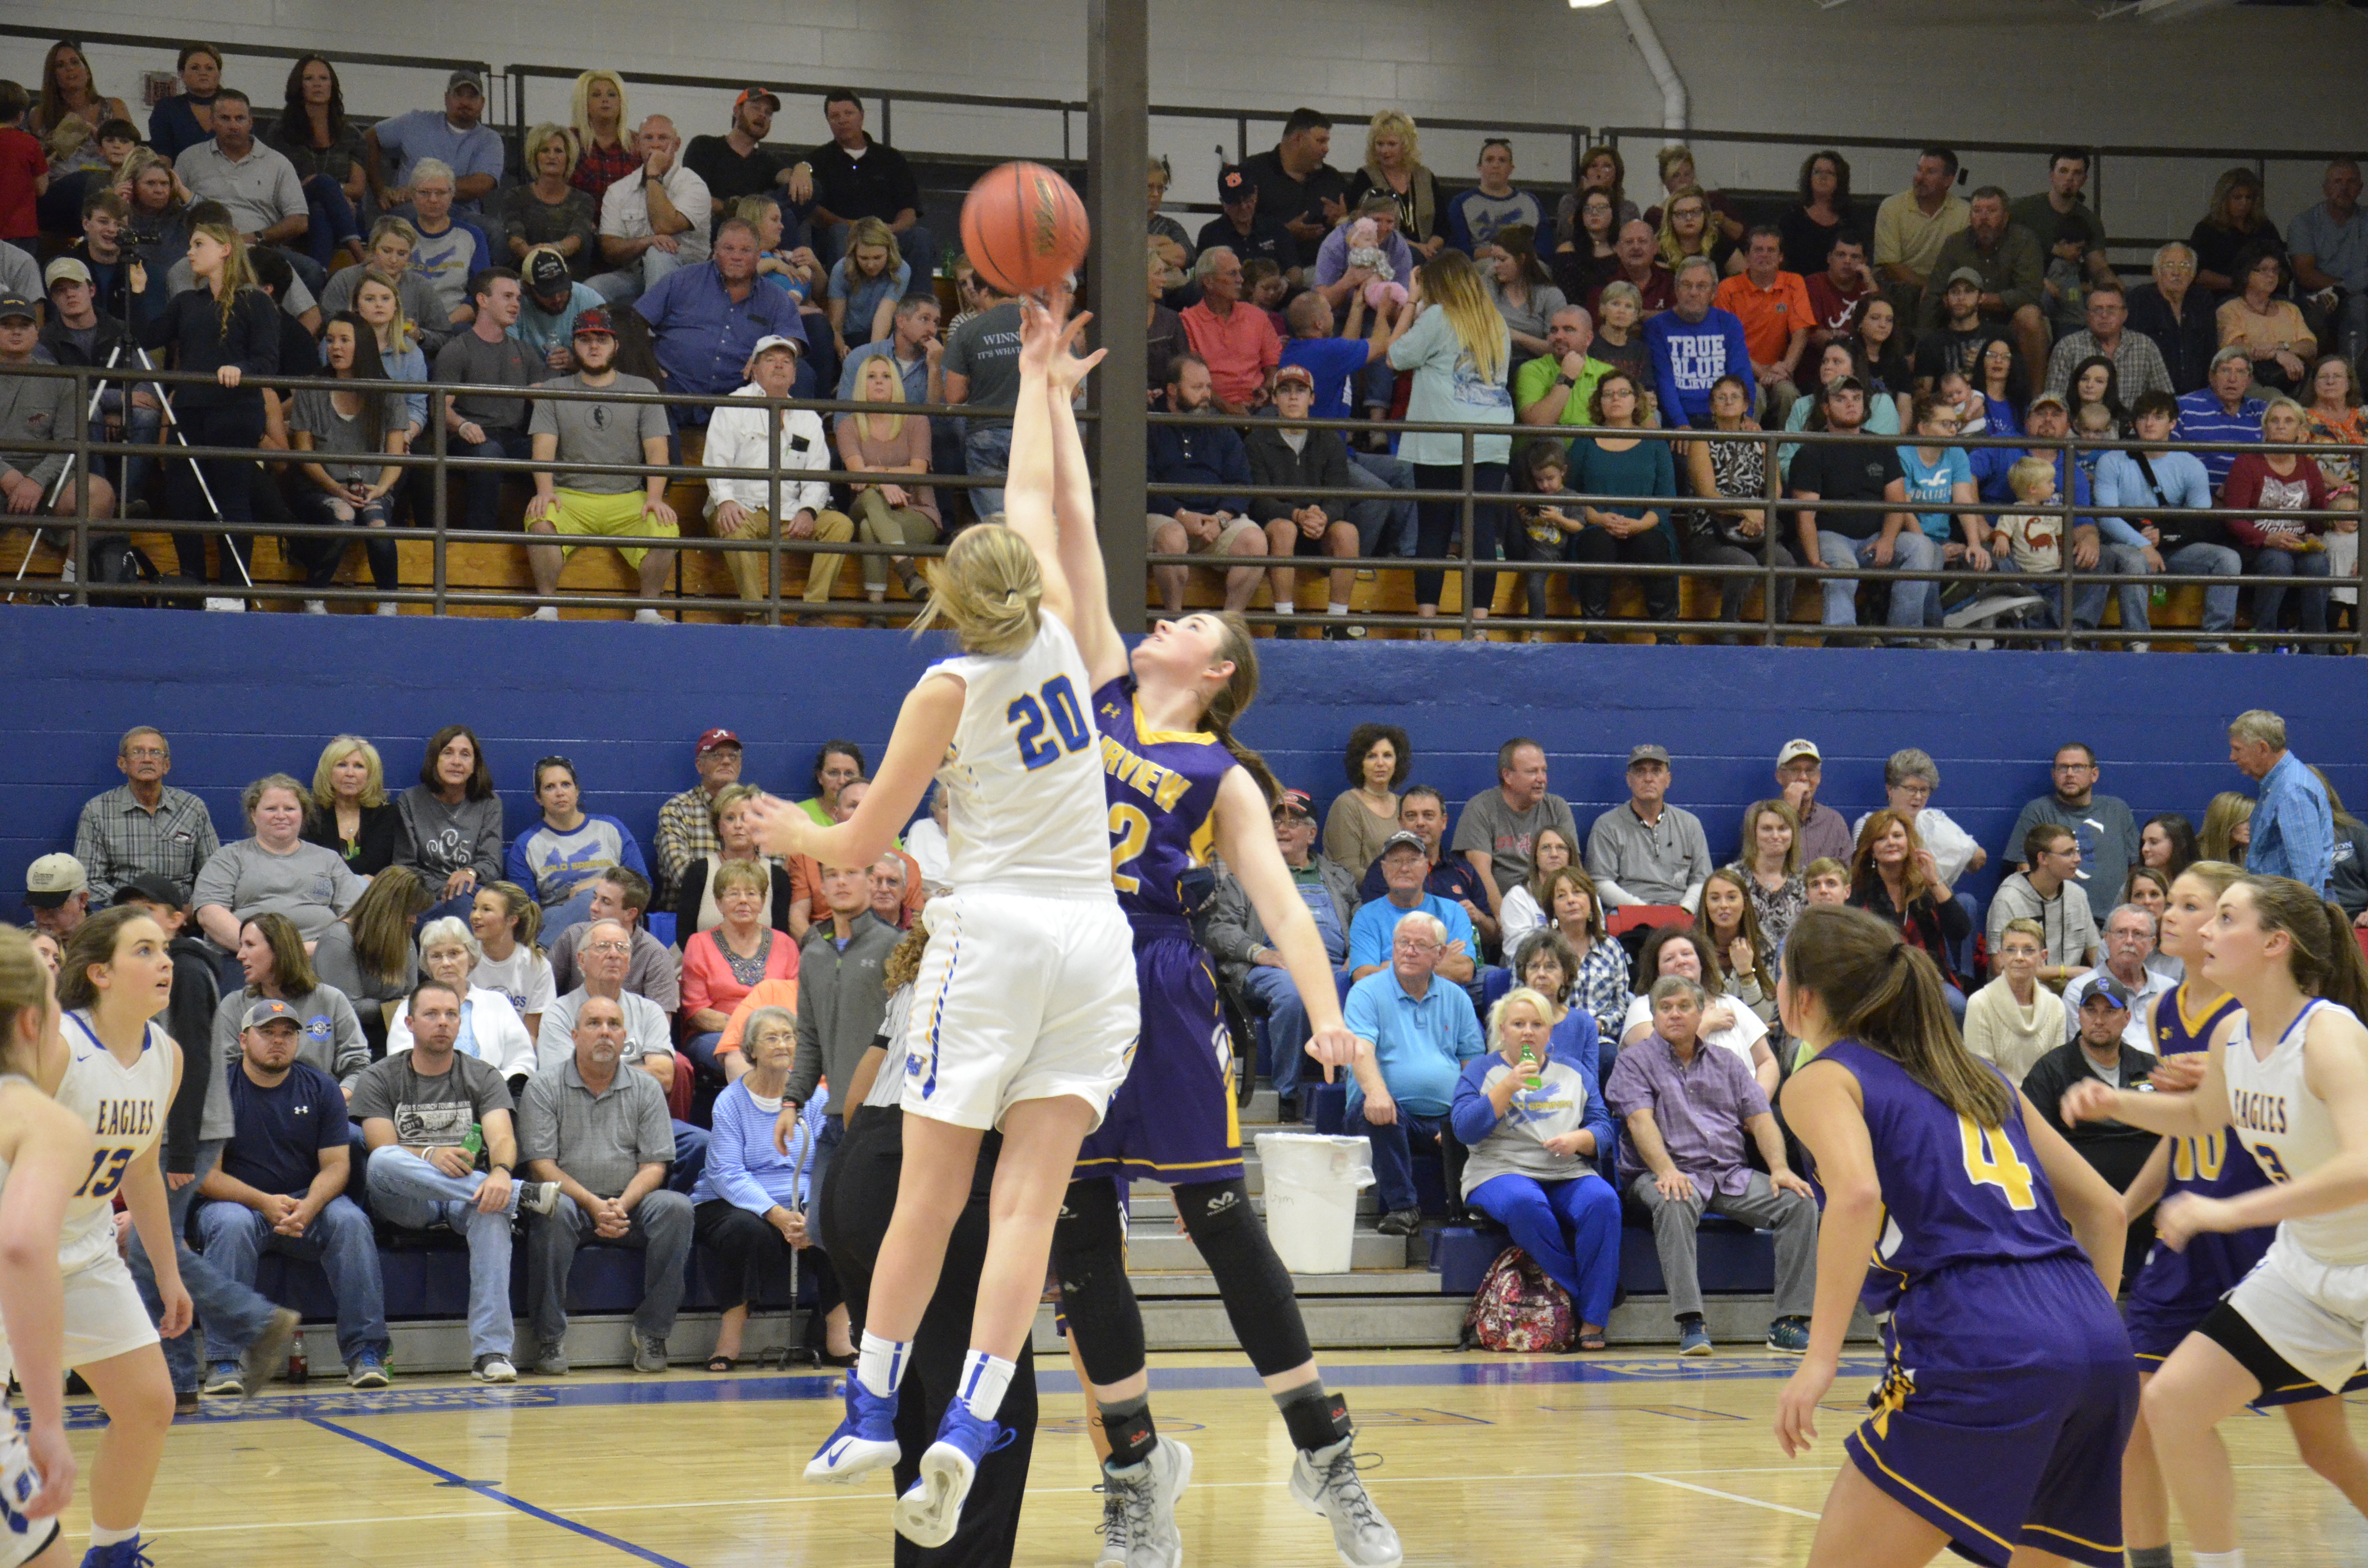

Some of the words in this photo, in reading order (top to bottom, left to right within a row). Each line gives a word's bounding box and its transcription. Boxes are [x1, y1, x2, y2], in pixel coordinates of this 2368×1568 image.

[995, 346, 1022, 355] WHAT
[1667, 334, 1725, 357] TRUE
[1671, 355, 1726, 379] BLUE
[1005, 673, 1092, 772] 20
[570, 859, 615, 870] SPRINGS
[96, 1099, 154, 1136] EAGLES
[417, 1103, 438, 1111] CHURCH
[438, 1101, 470, 1110] TOURNMENT
[426, 1110, 471, 1120] SOFTBALL
[2234, 1087, 2288, 1135] EAGLES
[72, 1145, 136, 1199] 13
[1957, 1115, 2037, 1211] 4
